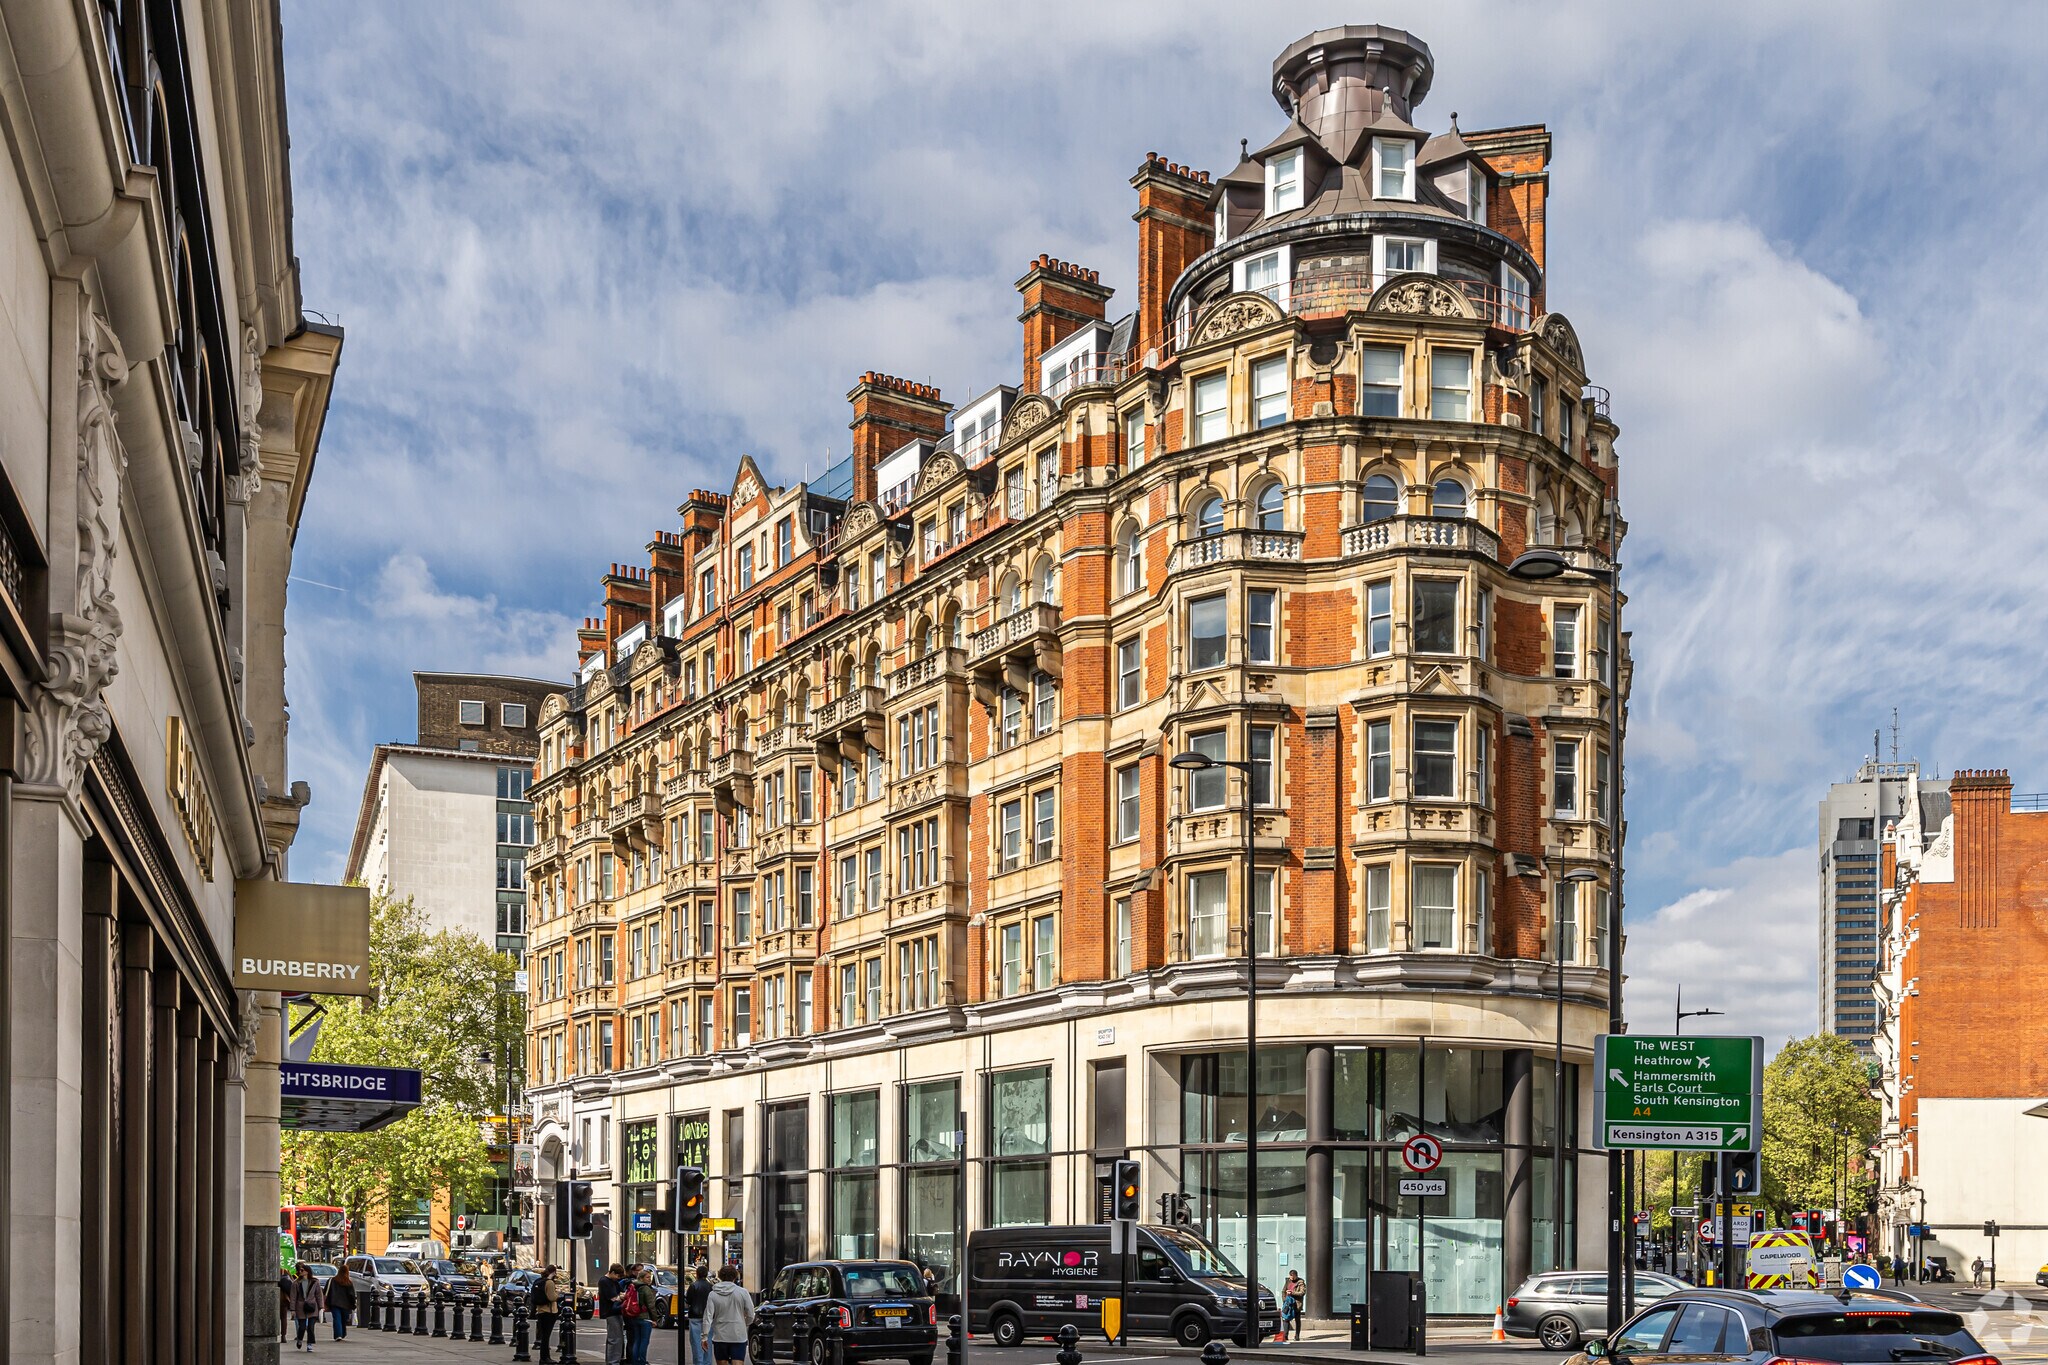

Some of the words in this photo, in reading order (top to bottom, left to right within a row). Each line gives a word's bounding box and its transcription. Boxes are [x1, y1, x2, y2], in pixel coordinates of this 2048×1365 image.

[242, 958, 361, 980] BURBERRY
[1634, 1041, 1655, 1050] The
[1660, 1041, 1695, 1051] WEST
[1634, 1056, 1692, 1066] Heathrow
[1634, 1071, 1716, 1082] Hammersmith
[1634, 1083, 1663, 1093] Earls
[1668, 1083, 1702, 1093] Court
[1634, 1095, 1669, 1105] South
[1674, 1096, 1740, 1108] Kensington
[1613, 1130, 1681, 1142] Kensington
[1403, 1183, 1424, 1191] 450
[1426, 1183, 1443, 1193] yds
[999, 1251, 1099, 1267] RAYNOR
[1052, 1268, 1098, 1276] HYGIENE
